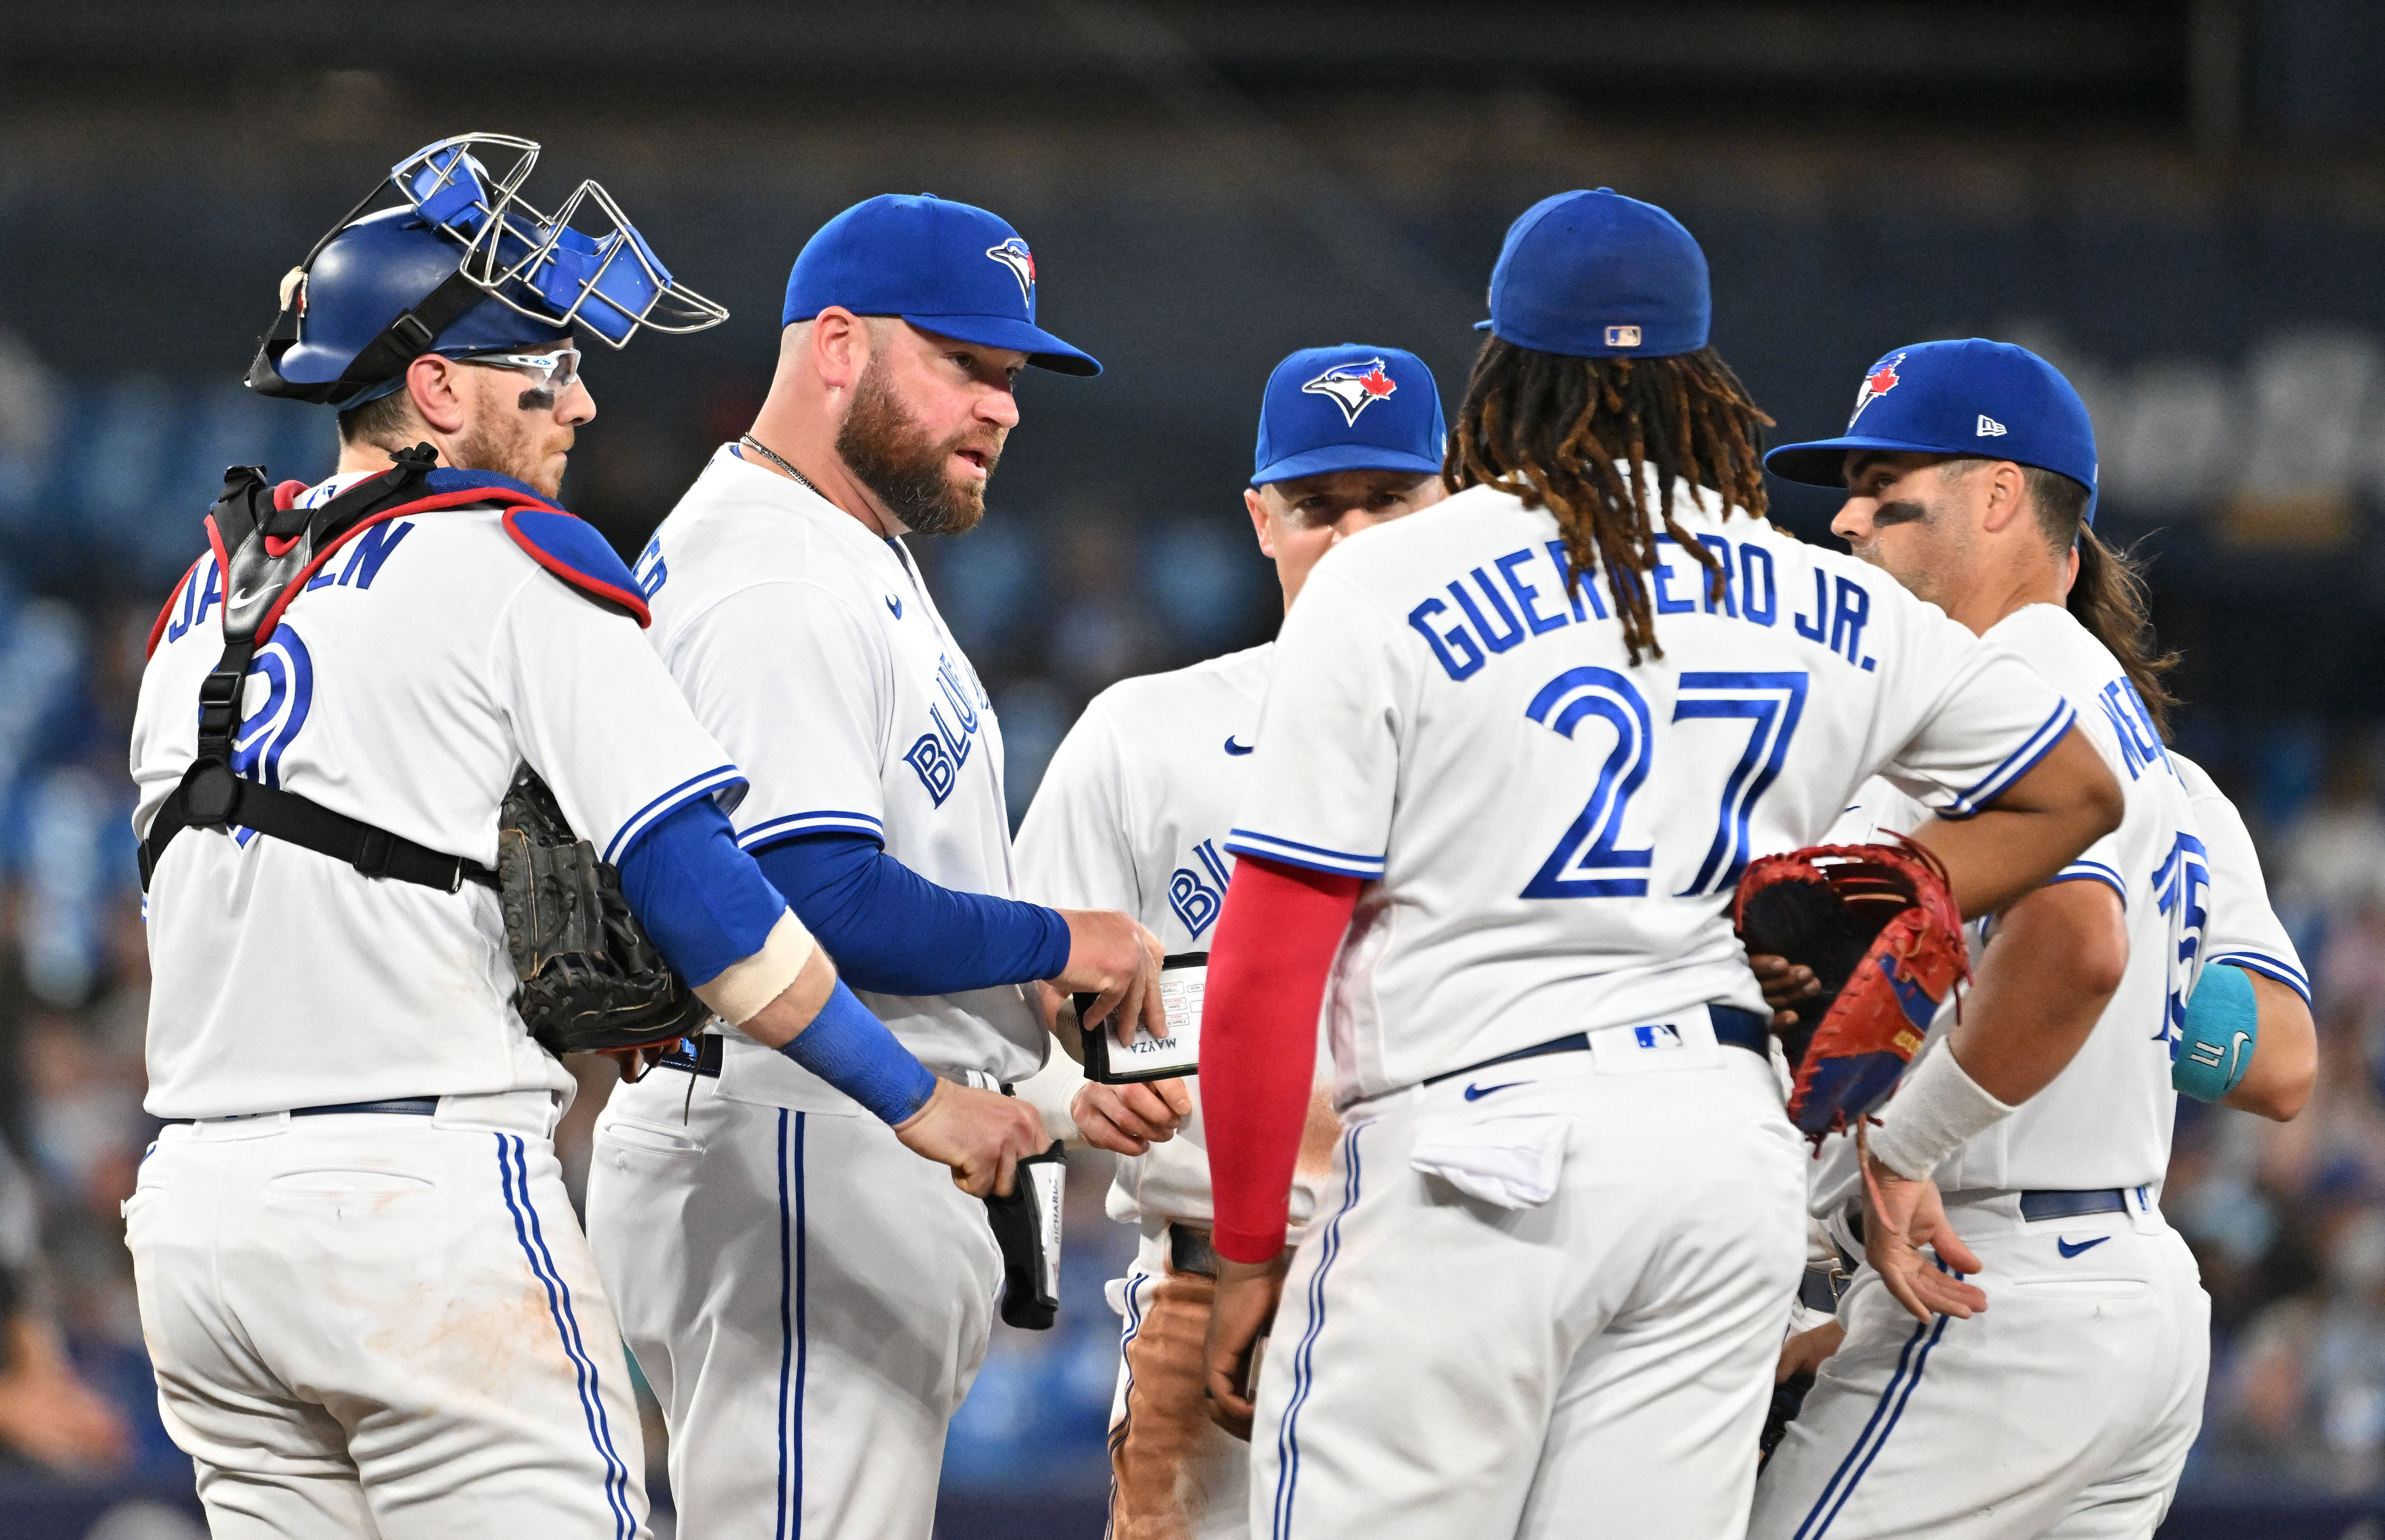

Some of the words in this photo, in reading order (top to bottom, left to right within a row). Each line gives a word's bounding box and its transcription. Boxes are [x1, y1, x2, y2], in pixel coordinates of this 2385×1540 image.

[1408, 532, 1778, 682] GUERERO
[1795, 567, 1876, 672] JR.
[1519, 666, 1809, 899] 27
[1130, 1038, 1177, 1054] MAYZA
[2189, 1040, 2226, 1069] 11
